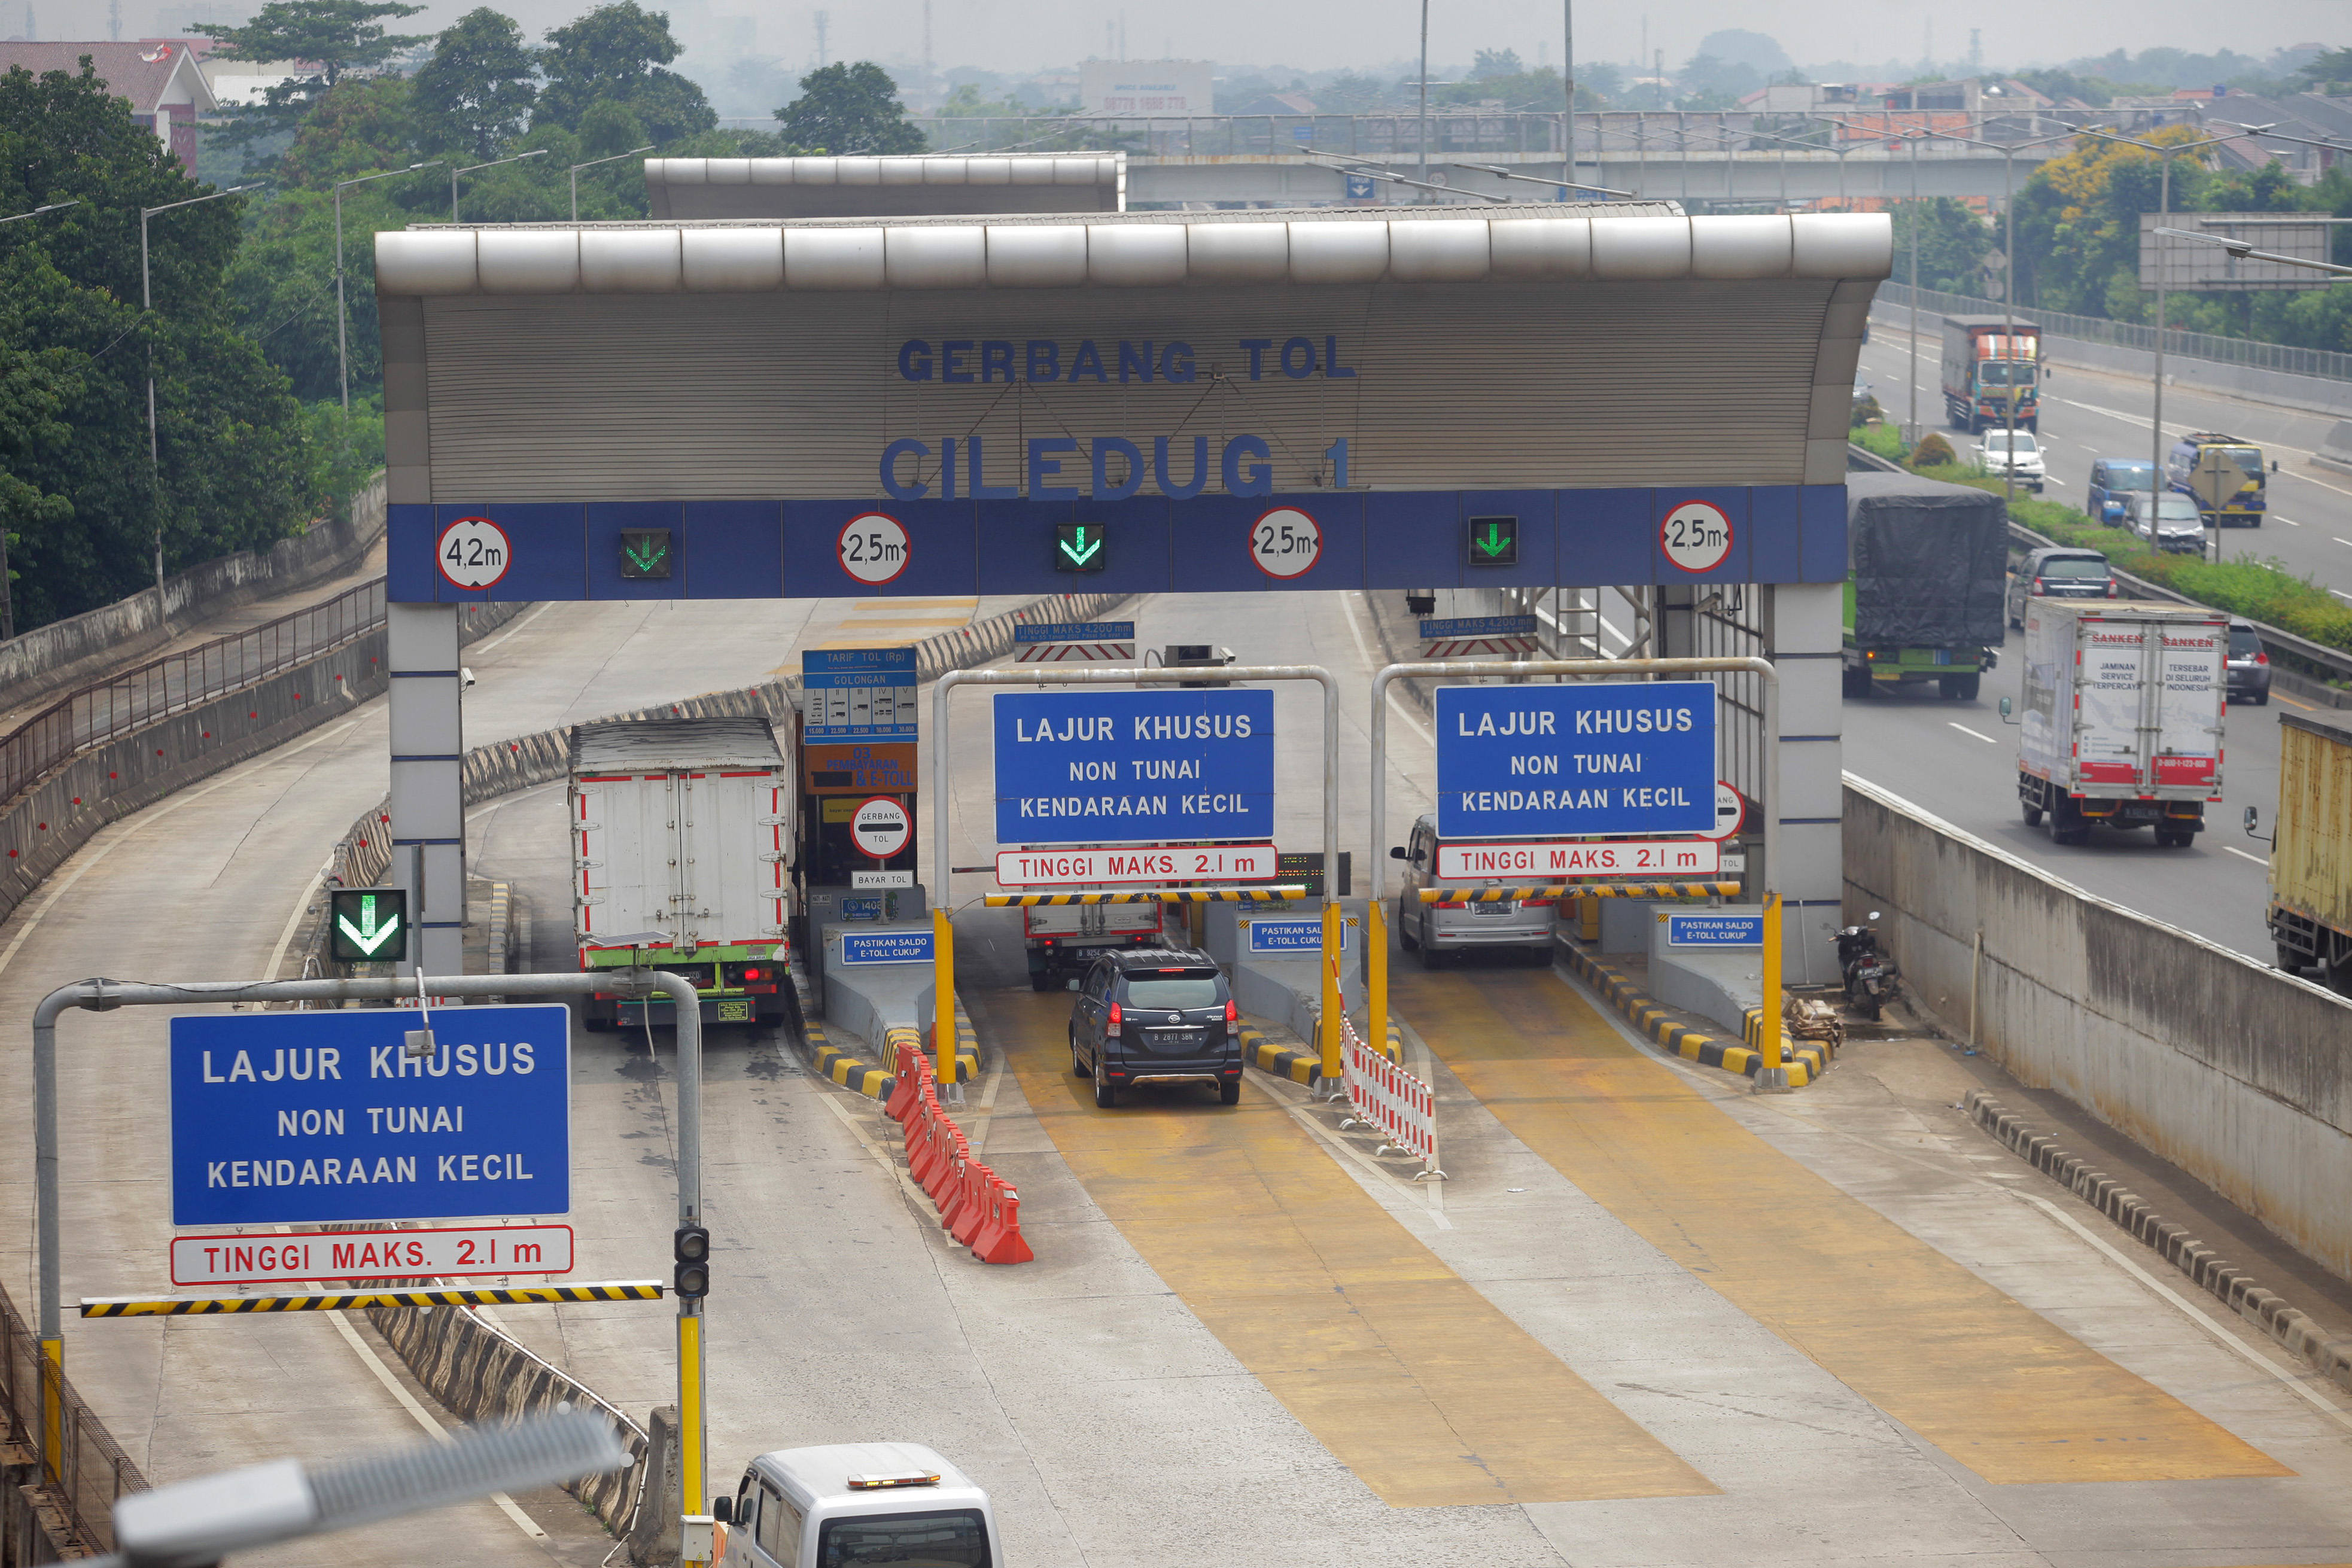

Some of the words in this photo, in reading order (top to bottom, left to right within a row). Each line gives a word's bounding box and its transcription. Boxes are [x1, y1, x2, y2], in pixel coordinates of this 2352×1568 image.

[897, 339, 1196, 384] GERBANG
[1240, 335, 1356, 381] TOL
[880, 434, 1272, 502] CILEDUG
[1325, 437, 1347, 489] 1
[1260, 526, 1312, 558] 2,5m
[1672, 519, 1721, 551] 2,5m
[446, 537, 501, 570] 4,2m
[848, 533, 900, 566] 2,5m
[1018, 626, 1048, 636] TINGGI
[1053, 625, 1081, 634] MAKS
[1085, 624, 1112, 634] 4.200
[1423, 620, 1453, 630] TINGGI
[1458, 619, 1484, 628] MAKS
[1489, 617, 1516, 627] 4.200
[1518, 617, 1533, 626] mm
[2093, 634, 2144, 643] SANKEN
[2162, 637, 2214, 647] SANKEN
[827, 653, 854, 662] TARIF
[862, 652, 881, 661] TOL
[886, 651, 905, 663] (Rp)
[2169, 664, 2208, 672] TERSEBAR
[834, 675, 886, 685] GOLONGAN
[1017, 717, 1113, 742] LAJUR
[1134, 714, 1252, 740] KHUSUS
[1459, 711, 1556, 737] LAJUR
[1576, 708, 1693, 735] KHUSUS
[853, 747, 871, 759] 03
[1511, 754, 1558, 775] NON
[1574, 753, 1641, 774] TUNAI
[826, 759, 899, 771] PEMBAYARAN
[1069, 761, 1116, 781] NON
[1132, 759, 1200, 780] TUNAI
[856, 770, 867, 787] &
[871, 771, 914, 787] E-TOLL
[1020, 796, 1167, 818] KENDARAAN
[1182, 793, 1249, 815] KECIL
[1462, 788, 1609, 812] KENDARAAN
[1623, 787, 1690, 808] KECIL
[1018, 857, 1093, 878] TINGGI
[1109, 855, 1177, 876] MAKS.
[1235, 857, 1255, 872] m
[1461, 851, 1535, 872] TINGGI
[1550, 849, 1620, 870] MAKS.
[1677, 851, 1697, 867] m
[858, 876, 886, 884] BAYAR
[891, 875, 907, 884] TOL
[854, 939, 896, 948] PASTIKAN
[893, 948, 921, 957] CUKUP
[202, 1048, 342, 1083] LAJUR
[370, 1042, 535, 1079] KHUSUS
[278, 1109, 345, 1137] NON
[367, 1105, 464, 1134] TUNAI
[208, 1156, 416, 1189] KENDARAAN
[437, 1152, 534, 1181] KECIL
[204, 1245, 310, 1274] TINGGI
[332, 1241, 432, 1269] MAKS.
[513, 1242, 541, 1263] m
